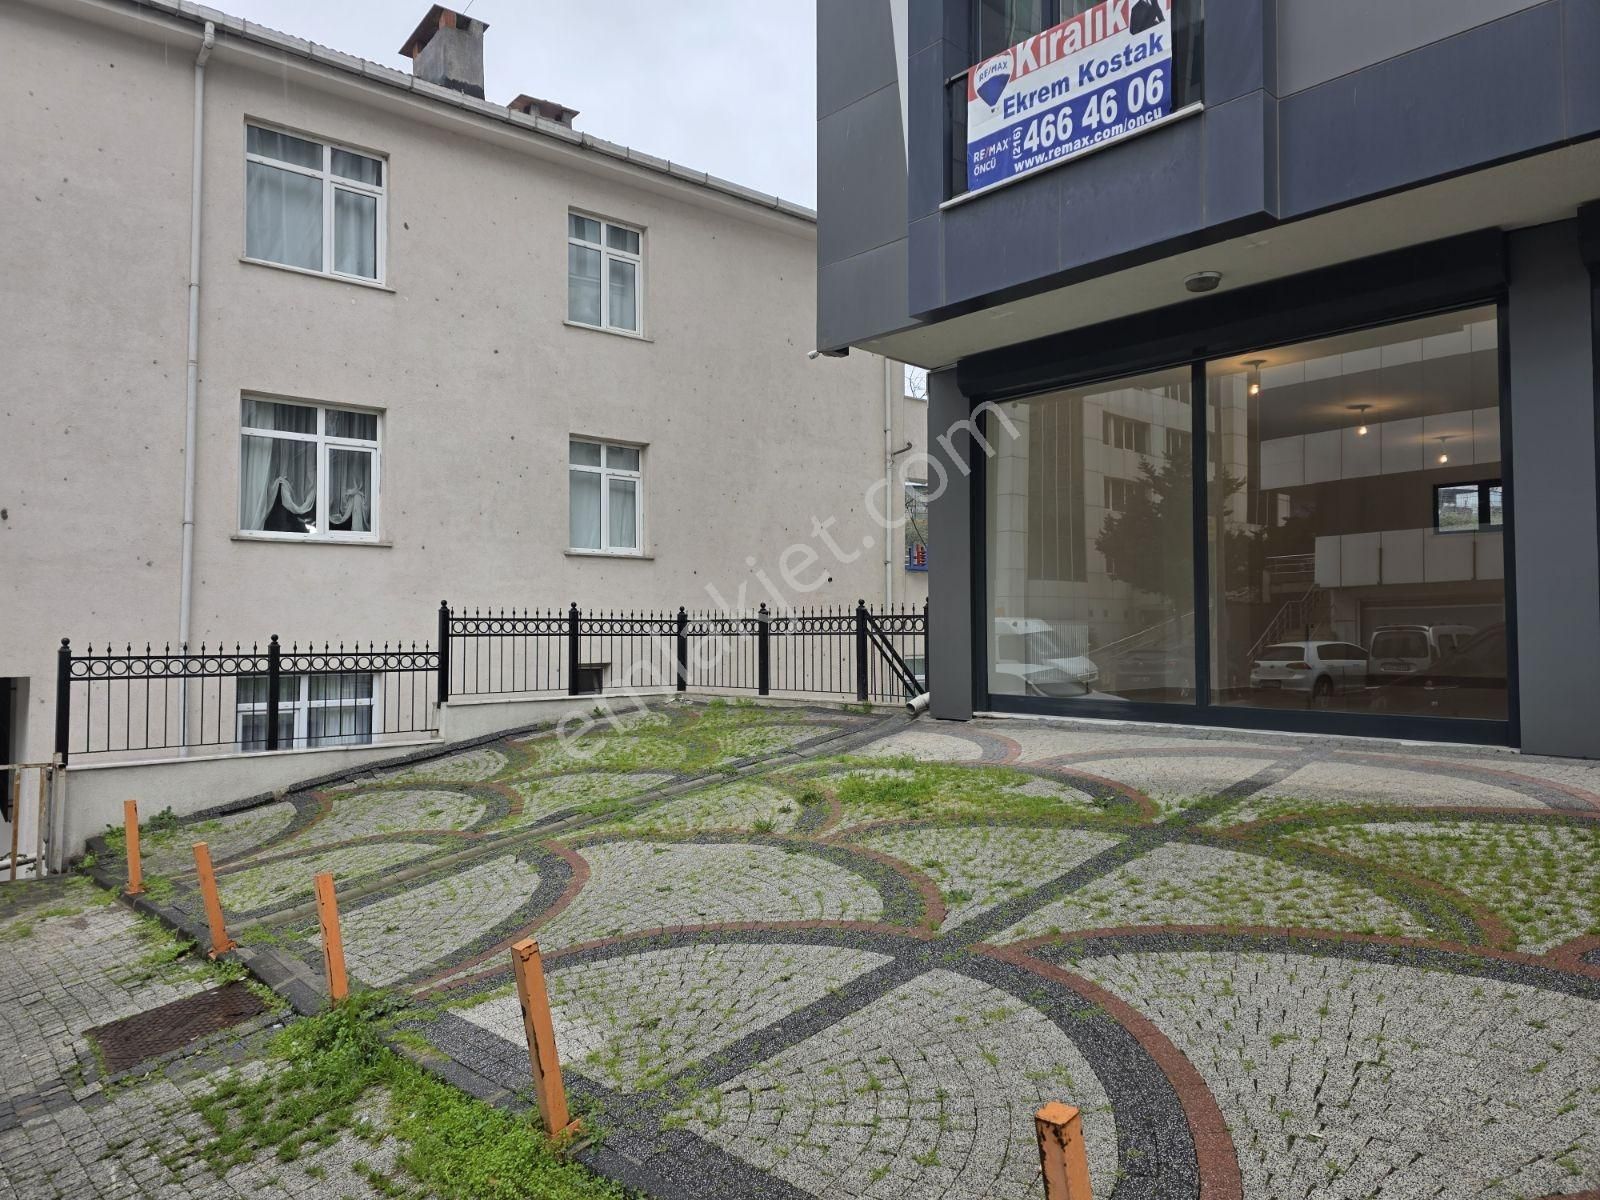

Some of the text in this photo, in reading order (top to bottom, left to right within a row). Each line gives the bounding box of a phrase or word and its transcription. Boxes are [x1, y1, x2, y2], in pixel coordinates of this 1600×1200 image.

[978, 61, 1008, 82] RE/MAX
[1015, 0, 1129, 78] Kiralık
[1003, 32, 1164, 119] Ekrem Kostak
[1013, 68, 1164, 159] (216) 466 46 06
[1014, 107, 1163, 173] www.remax.com/oncu
[973, 138, 1009, 164] RE/MAX
[973, 158, 997, 176] ÖNCÜ
